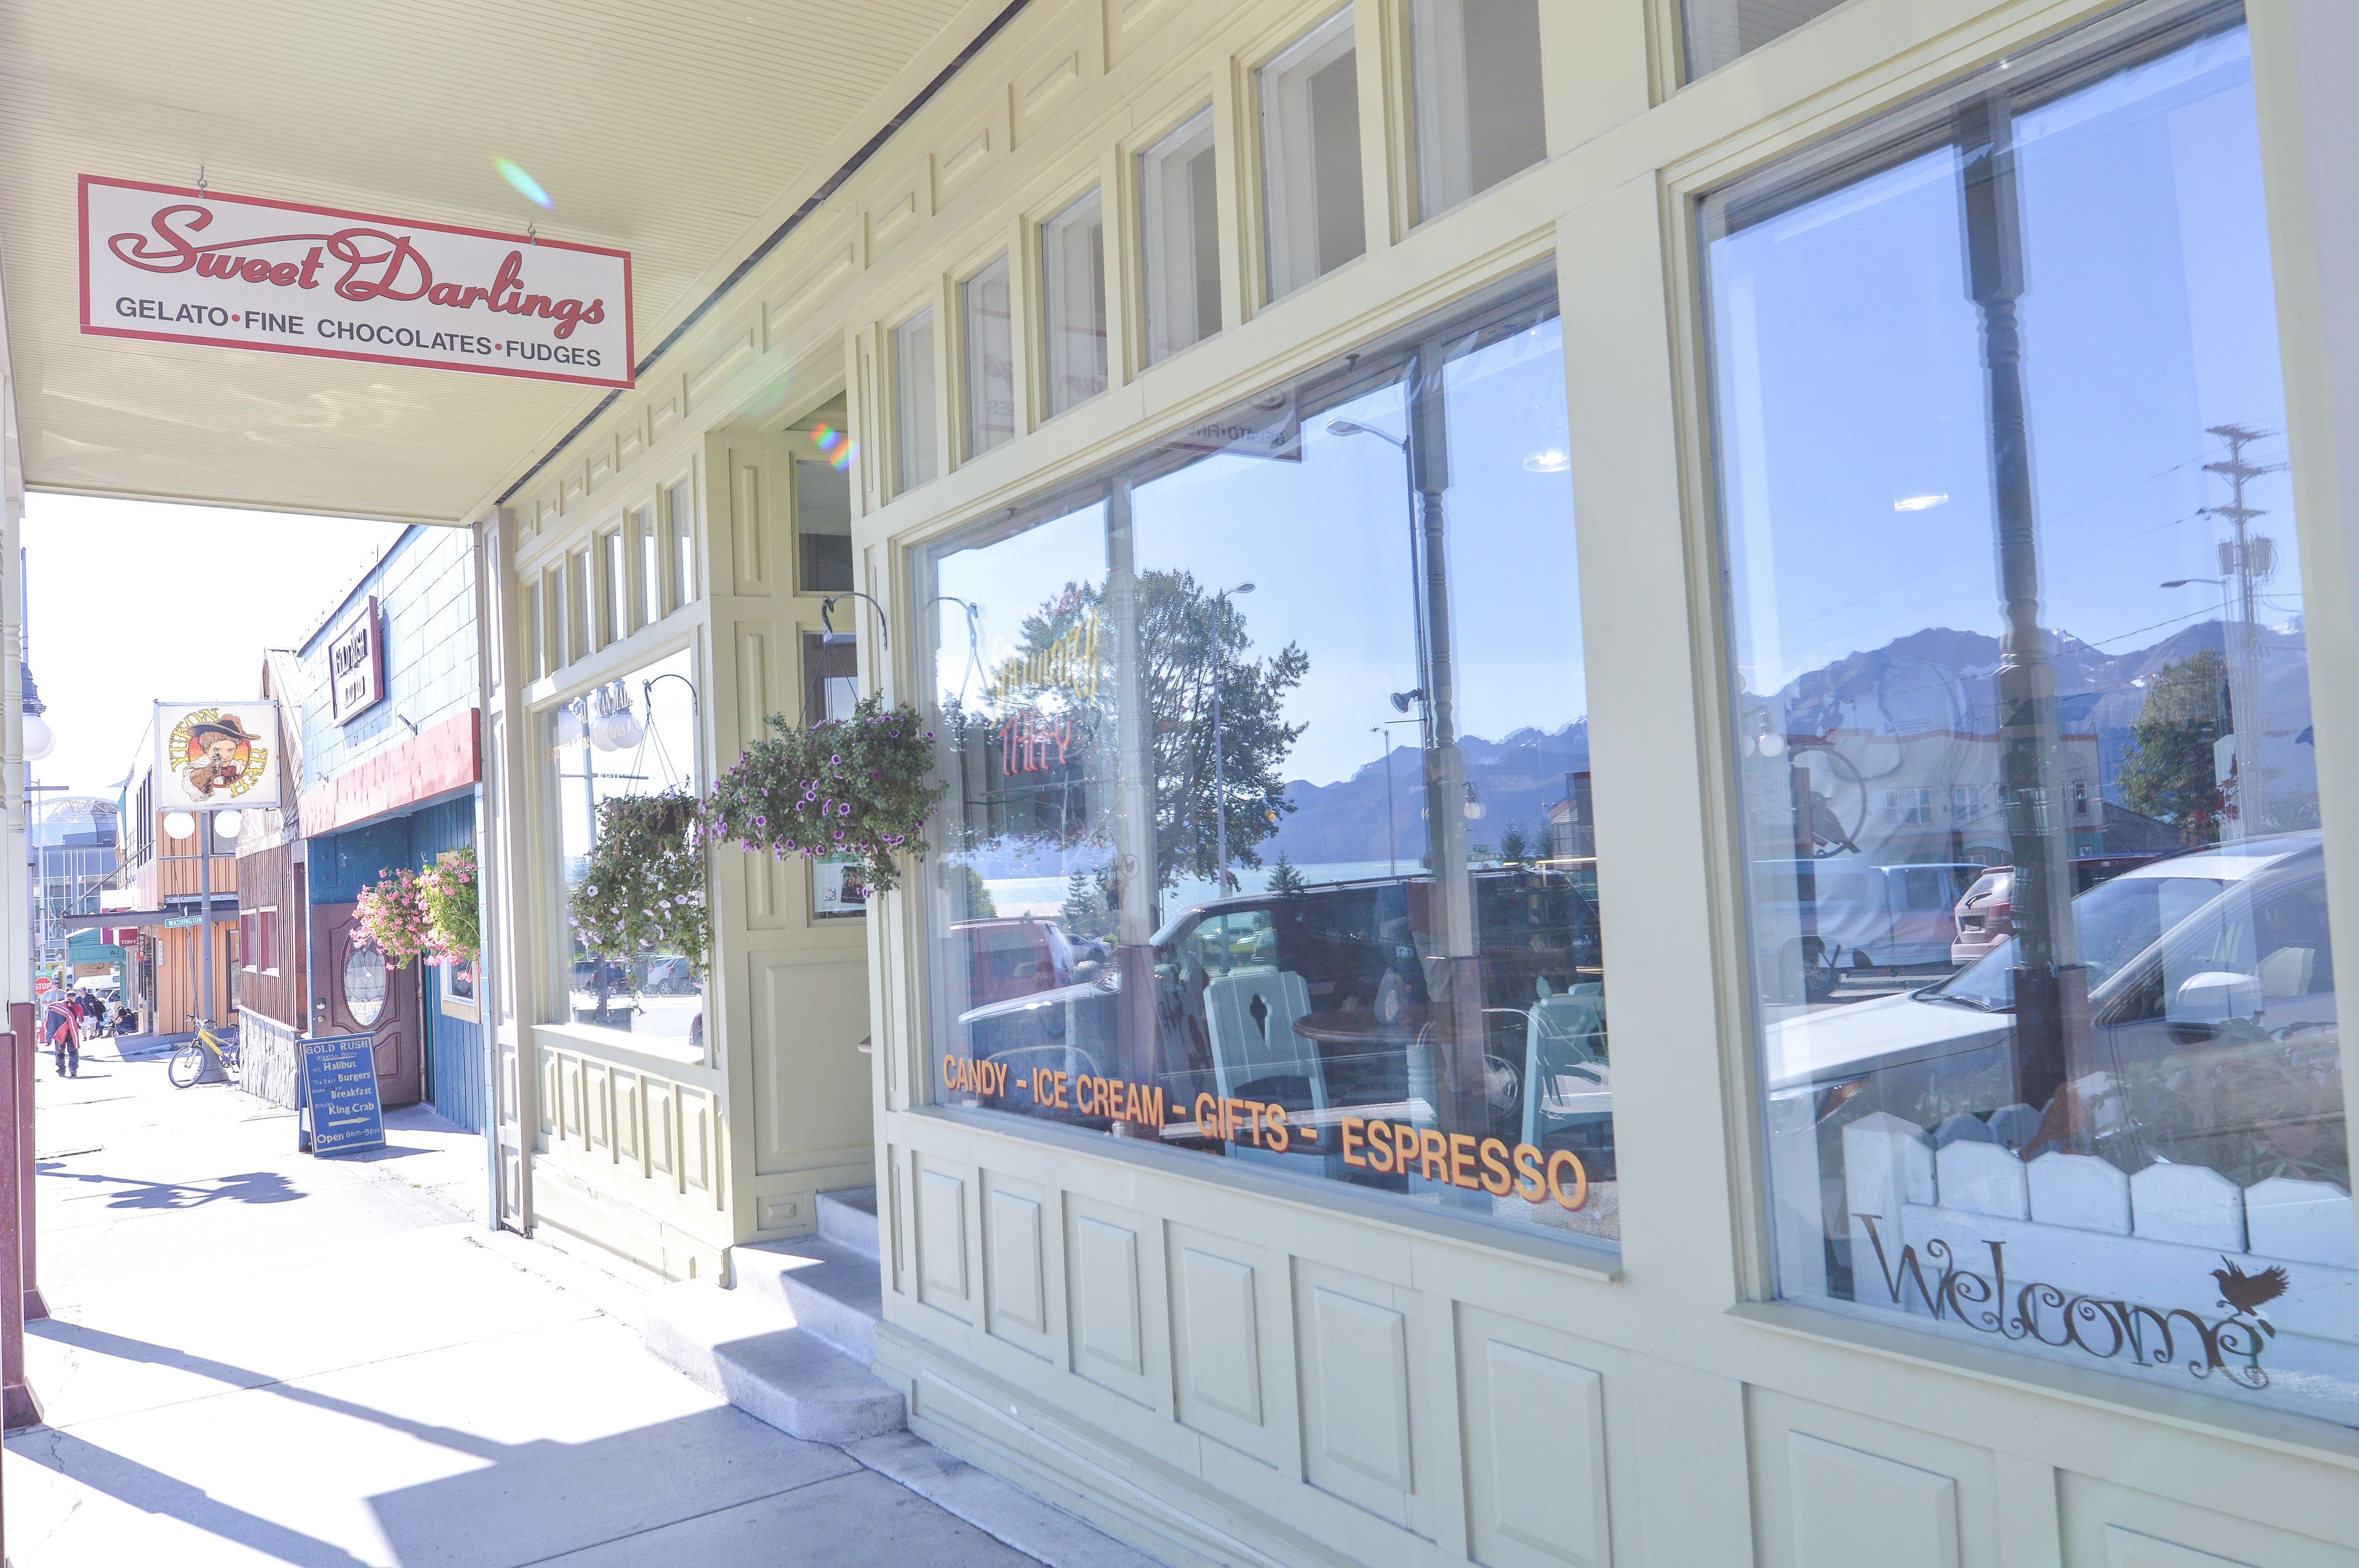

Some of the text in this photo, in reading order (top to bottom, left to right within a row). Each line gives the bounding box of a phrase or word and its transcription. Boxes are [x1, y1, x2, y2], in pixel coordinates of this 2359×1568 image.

[108, 205, 605, 339] Sweet Darlings
[115, 297, 601, 367] GELATO FINE CHOCOLATES FUDGES
[169, 708, 268, 798] YUKON BAR
[168, 916, 202, 927] WASHINGTON
[306, 1040, 368, 1054] GOLD RUSH
[323, 1061, 356, 1071] Halibut
[337, 1072, 371, 1082] Burgers
[331, 1087, 372, 1099] Breakfast
[329, 1101, 375, 1115] King Crab
[316, 1133, 344, 1144] Open
[943, 1054, 1590, 1212] CANDY ICE CREAM GIFTS ESPRESSO
[1851, 1214, 2271, 1390] Welcome
